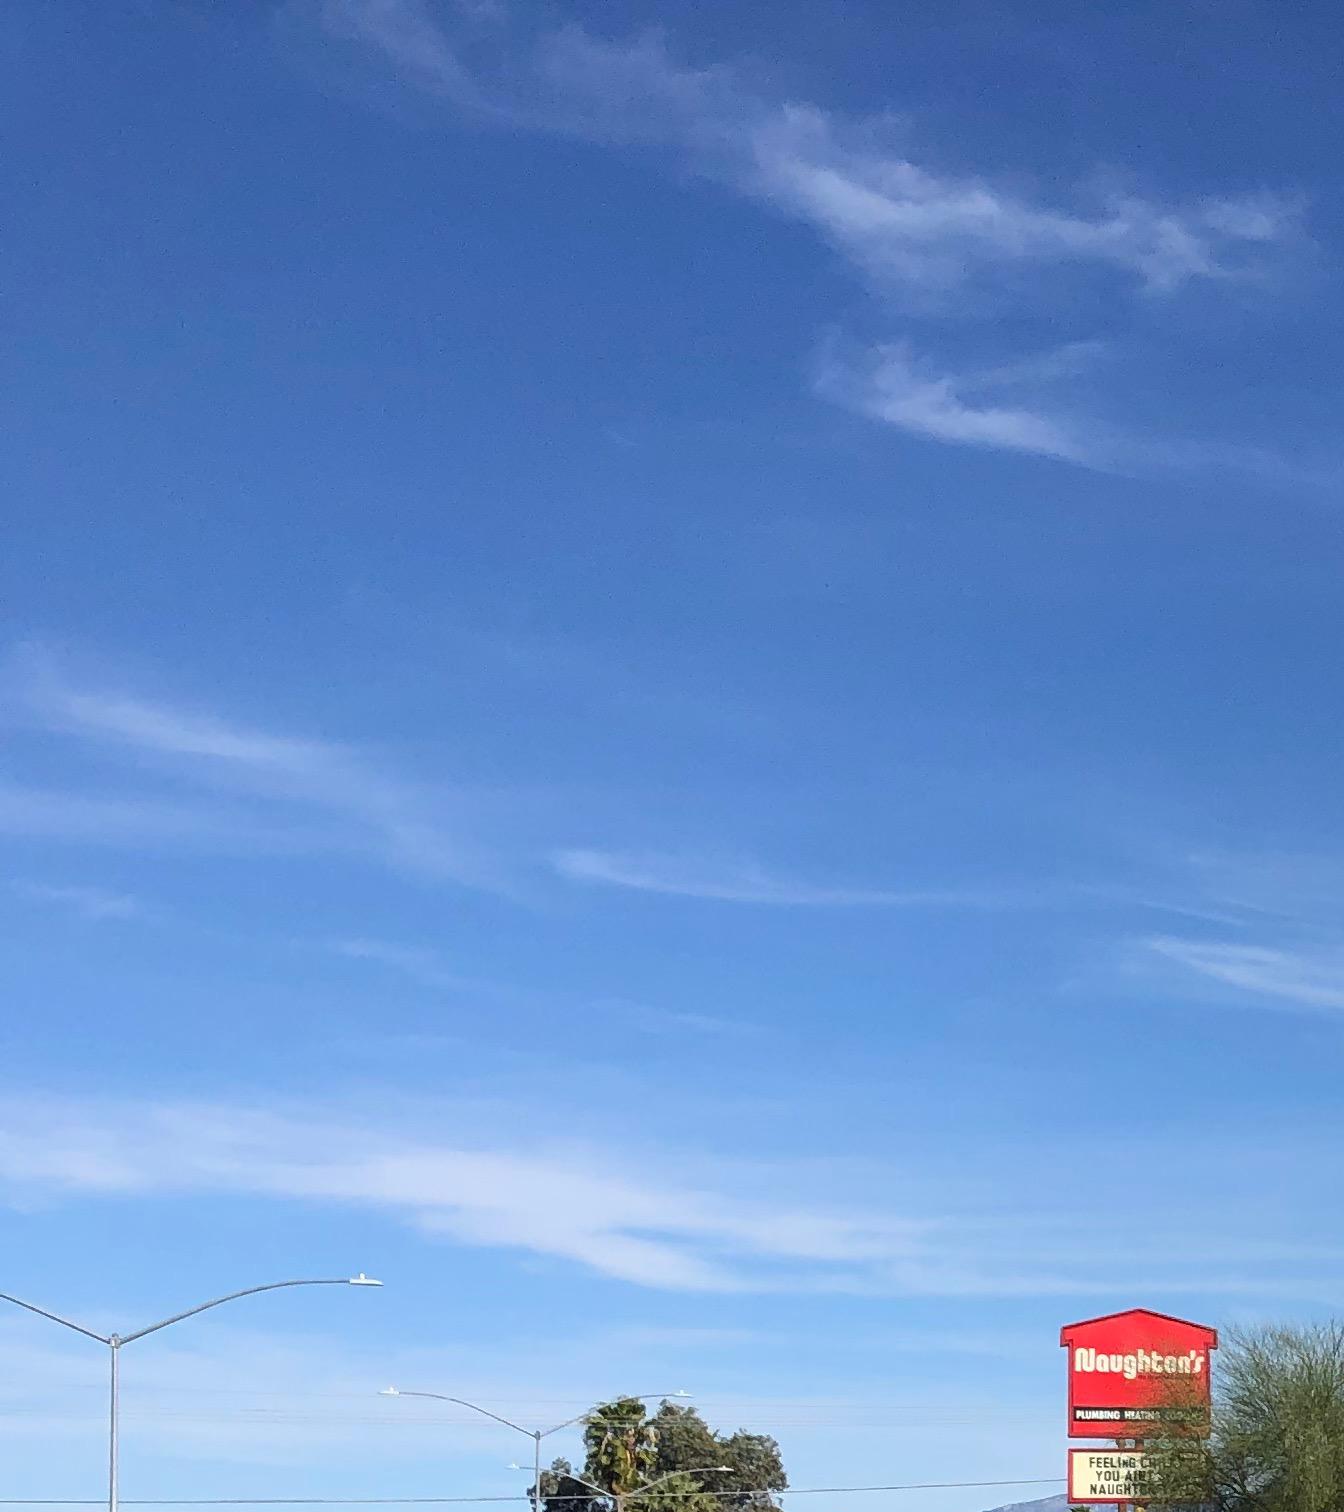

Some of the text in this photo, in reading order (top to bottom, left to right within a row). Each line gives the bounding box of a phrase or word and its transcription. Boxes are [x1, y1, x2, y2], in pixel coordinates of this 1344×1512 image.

[1075, 1347, 1205, 1380] Naughton's
[1075, 1409, 1121, 1421] PLUMBING
[1089, 1457, 1136, 1469] FEELING
[1095, 1471, 1120, 1482] YOU
